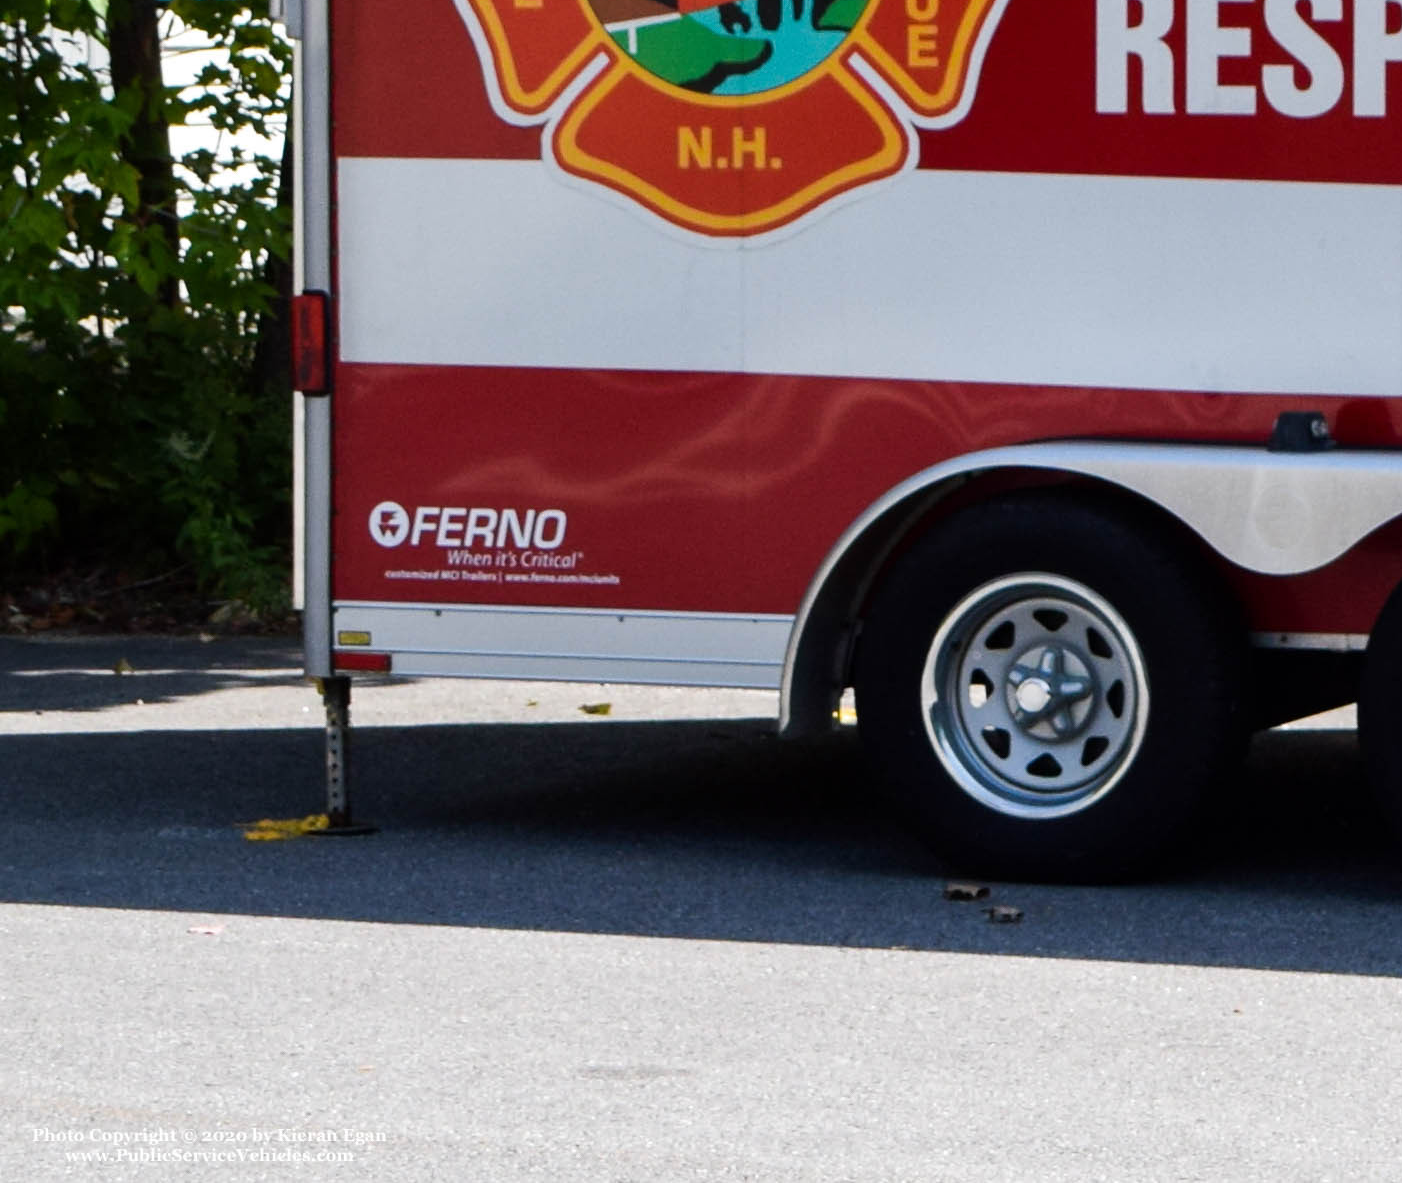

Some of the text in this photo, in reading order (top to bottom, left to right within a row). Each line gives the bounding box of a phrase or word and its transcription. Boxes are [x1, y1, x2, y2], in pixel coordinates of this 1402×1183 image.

[677, 126, 783, 168] N.H.
[410, 506, 568, 549] FERNO
[447, 550, 492, 566] When
[495, 550, 517, 567] it's
